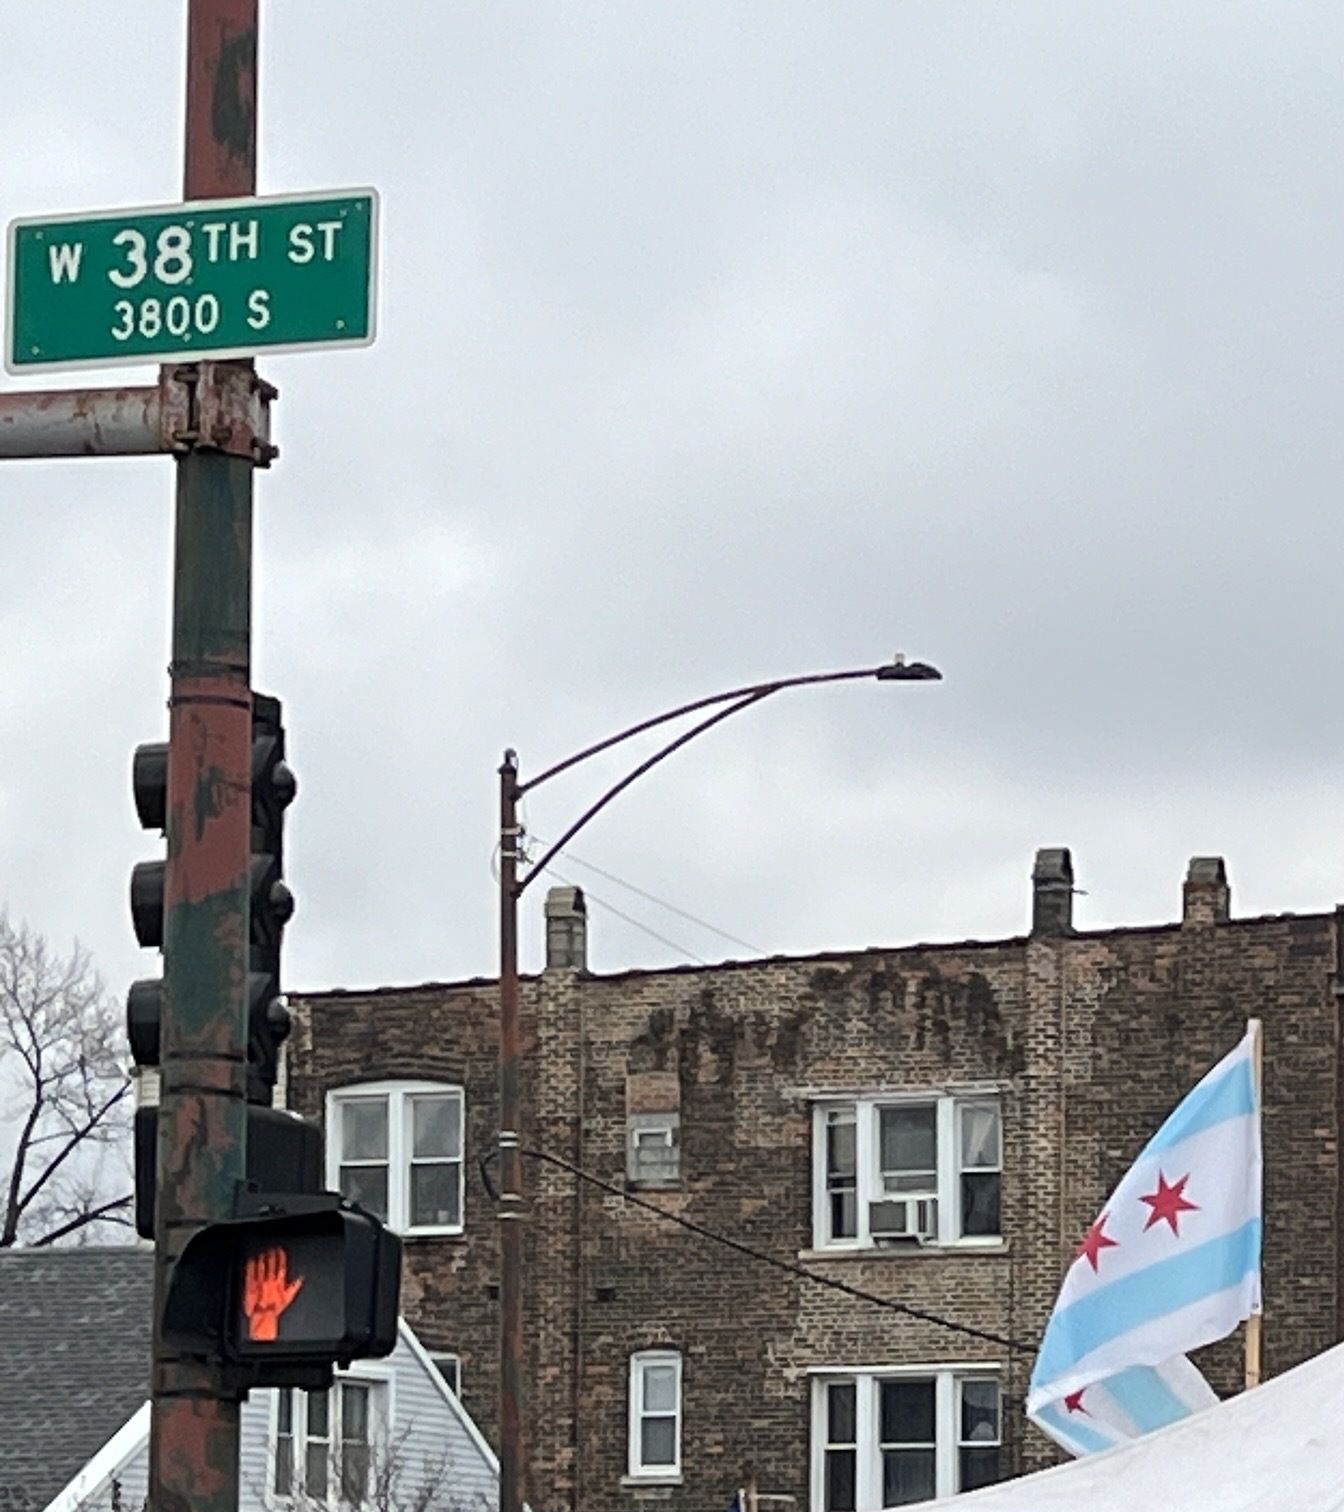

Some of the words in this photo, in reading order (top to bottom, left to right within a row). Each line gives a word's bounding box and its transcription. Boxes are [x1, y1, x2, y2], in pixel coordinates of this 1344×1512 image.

[49, 243, 83, 285] W
[108, 219, 259, 289] 38TH
[287, 221, 343, 264] ST
[110, 293, 219, 341] 3800
[246, 289, 271, 330] S
